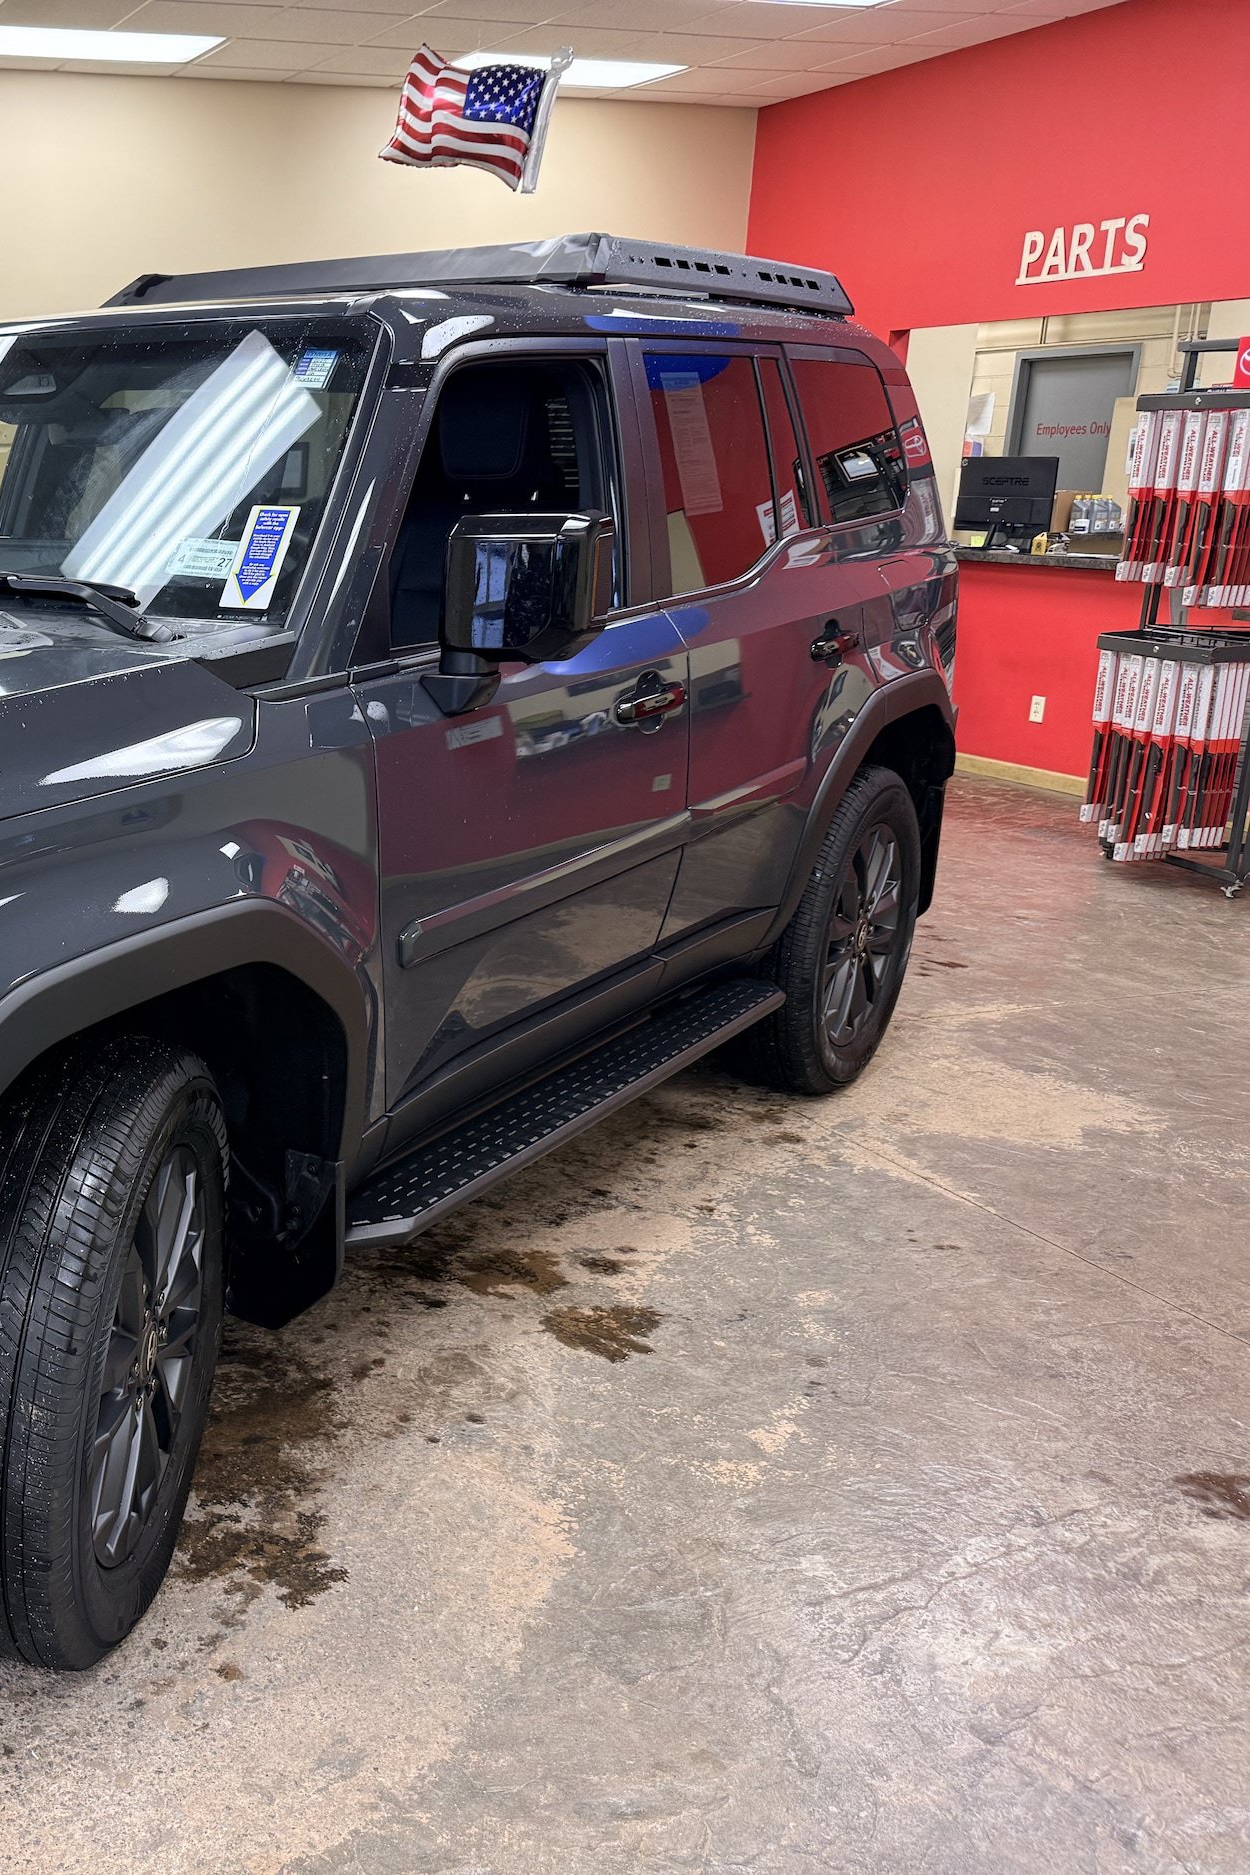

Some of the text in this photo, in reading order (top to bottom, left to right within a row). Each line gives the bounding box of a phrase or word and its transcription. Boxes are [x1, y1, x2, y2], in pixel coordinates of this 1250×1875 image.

[1017, 213, 1150, 283] PARTS
[1036, 421, 1111, 439] Employees Only
[1136, 428, 1146, 477] ALL-WEATHER
[1161, 428, 1171, 478] ALL-WEATHER
[1185, 429, 1196, 480] ALL-WEATHER
[1207, 430, 1218, 481] ALL-WEATHER
[982, 477, 1030, 486] SCEPTRE
[217, 557, 233, 568] 27
[1098, 665, 1107, 712] ALL-WEATHER
[1141, 673, 1152, 721] ALL-WEATHER
[1158, 677, 1169, 725] ALL-WEATHER
[1182, 677, 1194, 726] ALL-WEATHER
